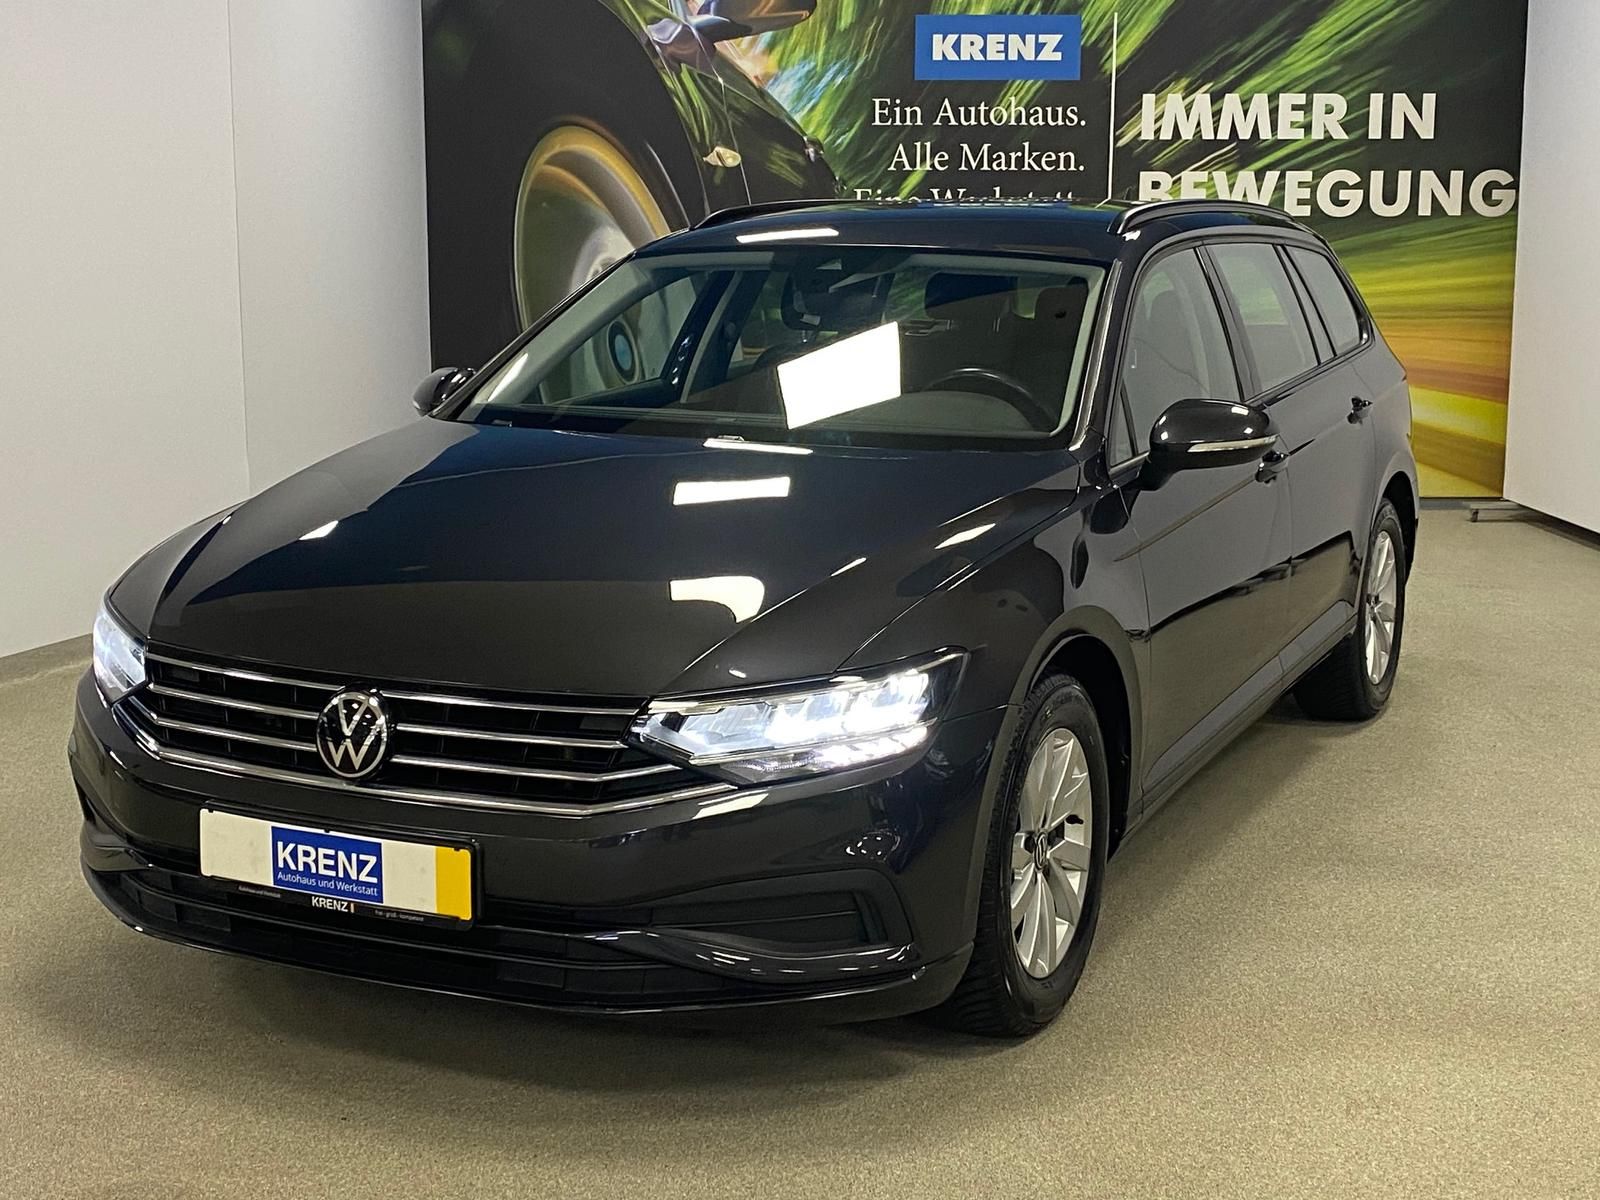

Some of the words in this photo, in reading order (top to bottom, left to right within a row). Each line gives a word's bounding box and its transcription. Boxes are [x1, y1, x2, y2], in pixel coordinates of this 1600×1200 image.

[931, 33, 1064, 61] KRENZ
[871, 97, 923, 126] Ein
[934, 97, 1087, 127] Autohaus.
[1140, 93, 1349, 141] IMMER
[1367, 92, 1437, 140] IN
[887, 142, 949, 172] Alle
[959, 141, 1085, 172] Marken.
[1139, 169, 1516, 217] BEWEGUNG
[277, 841, 378, 884] KRENZ
[277, 871, 317, 887] Autohaus
[317, 880, 335, 889] und
[335, 881, 378, 897] Werkstatt
[311, 896, 349, 913] KRENZ
